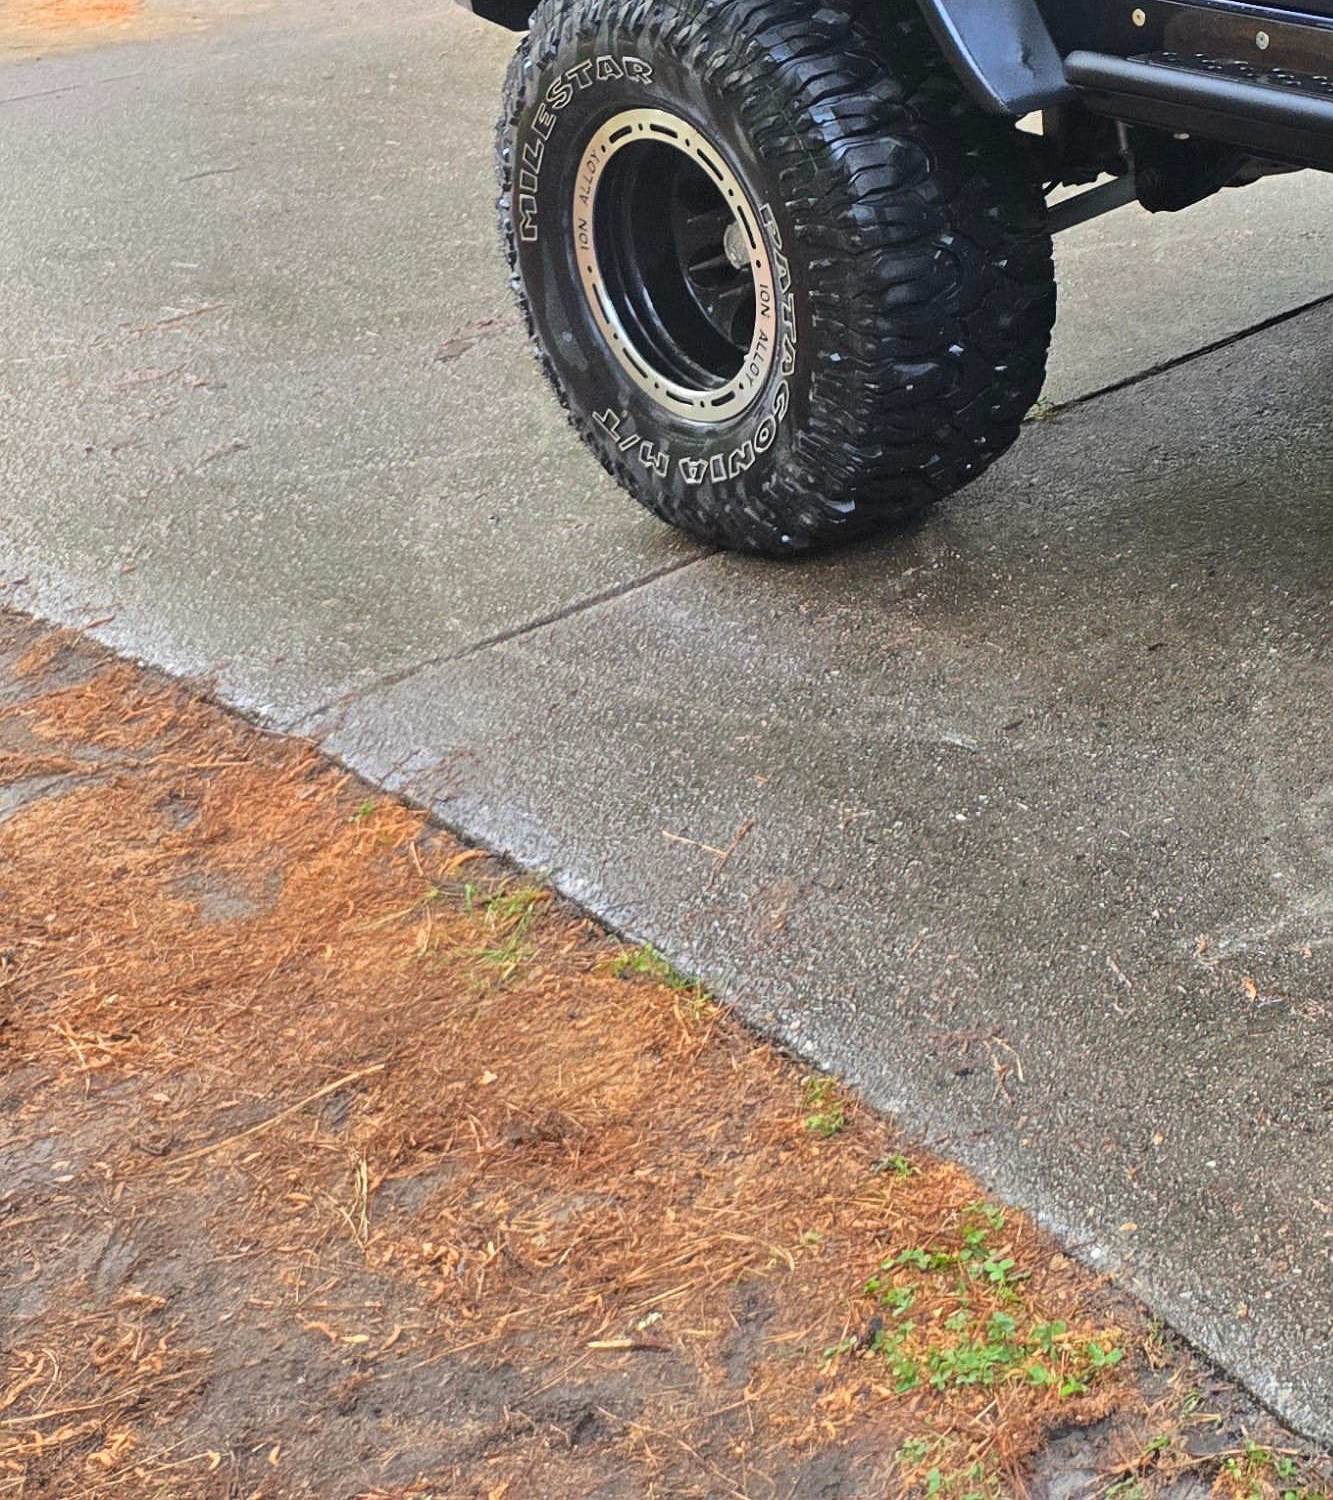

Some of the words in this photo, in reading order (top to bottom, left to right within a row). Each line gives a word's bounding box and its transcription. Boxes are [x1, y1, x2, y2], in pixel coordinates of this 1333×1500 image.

[519, 55, 653, 241] MILESTAR
[579, 148, 601, 208] ALLOY
[578, 218, 590, 250] ION
[759, 284, 771, 318] ION
[678, 203, 797, 484] PATAGONIA
[746, 328, 770, 389] ALLOY
[592, 408, 671, 478] M/T
